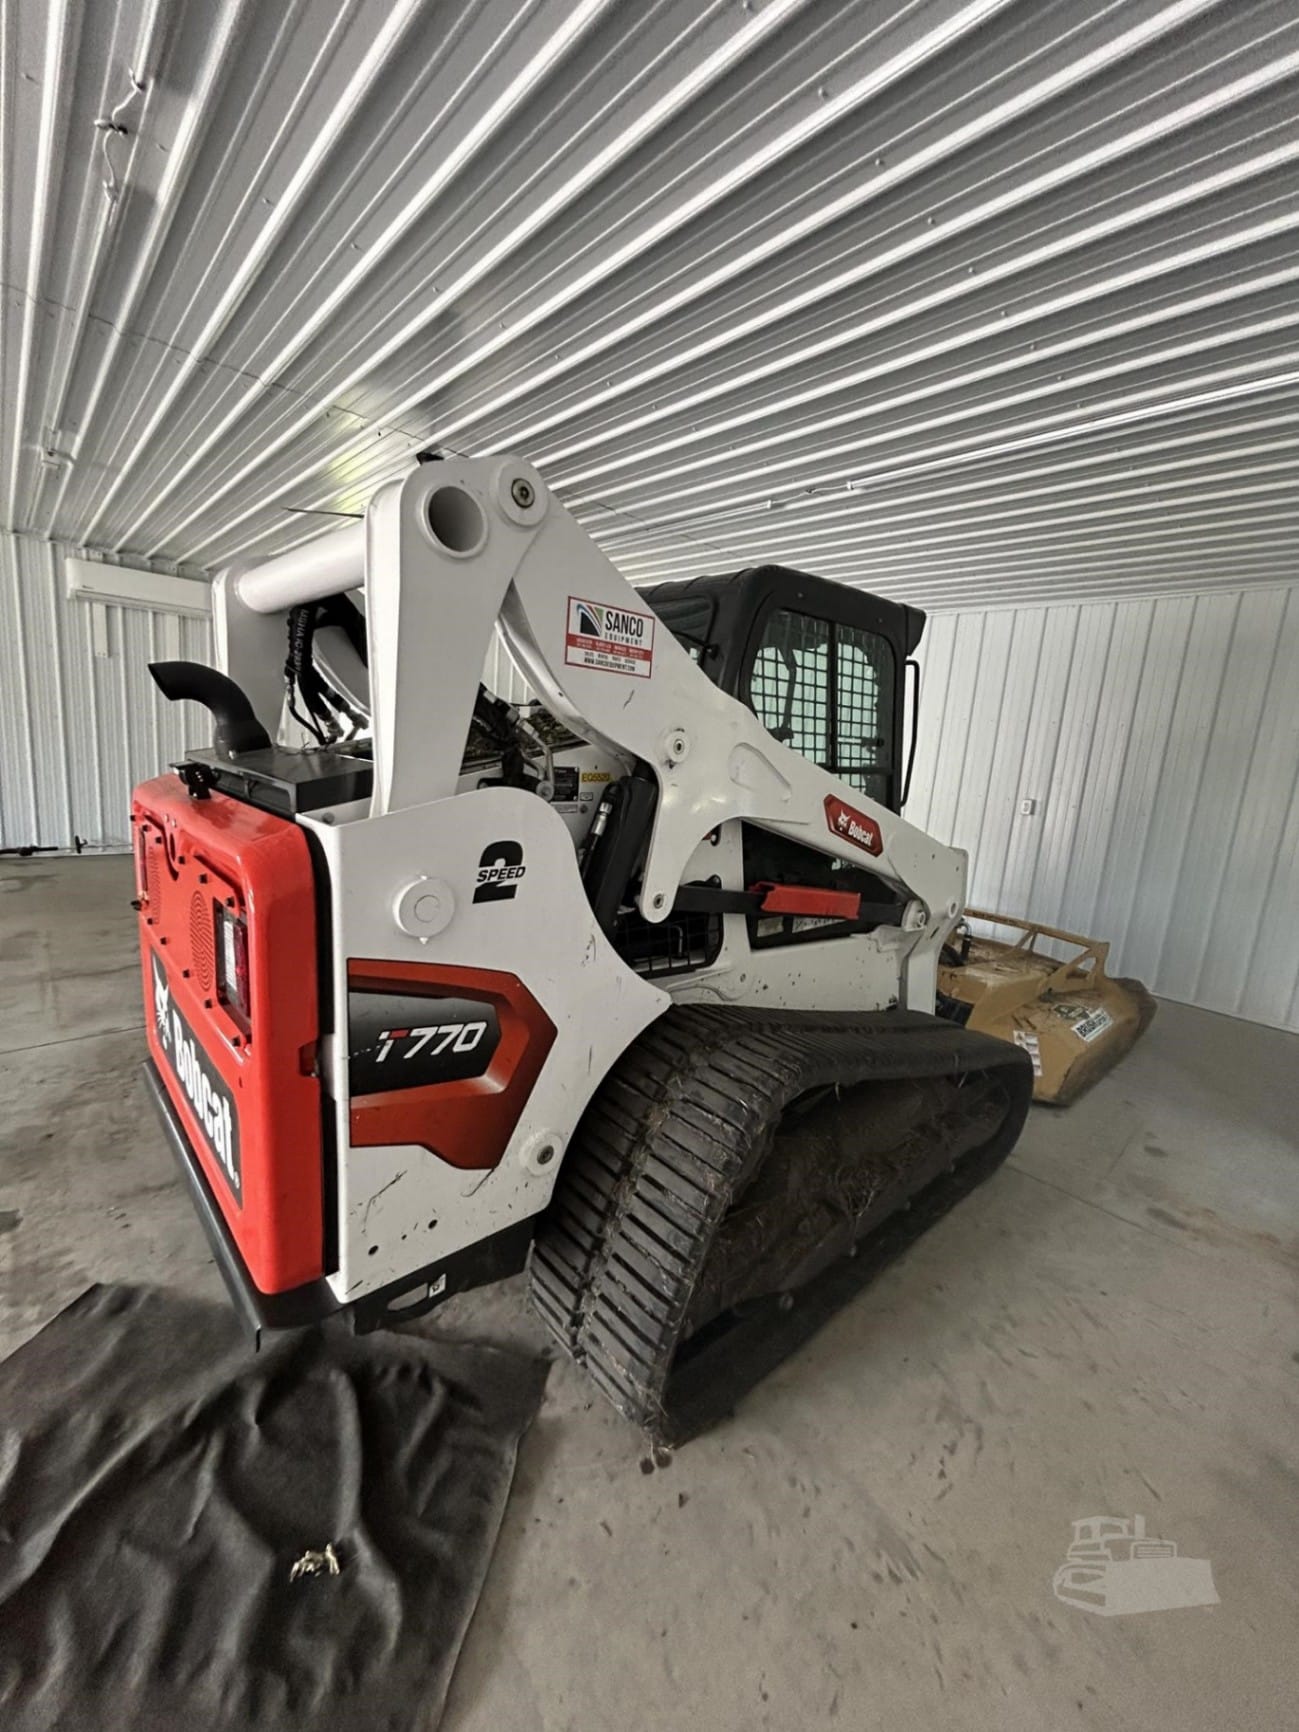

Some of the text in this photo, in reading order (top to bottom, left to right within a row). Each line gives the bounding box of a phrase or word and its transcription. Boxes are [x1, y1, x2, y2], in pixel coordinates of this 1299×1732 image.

[605, 611, 643, 637] SANCO
[849, 820, 874, 847] Bobcat
[476, 866, 526, 883] SPEED
[375, 1021, 488, 1063] T770
[172, 1009, 235, 1181] Bobcat
